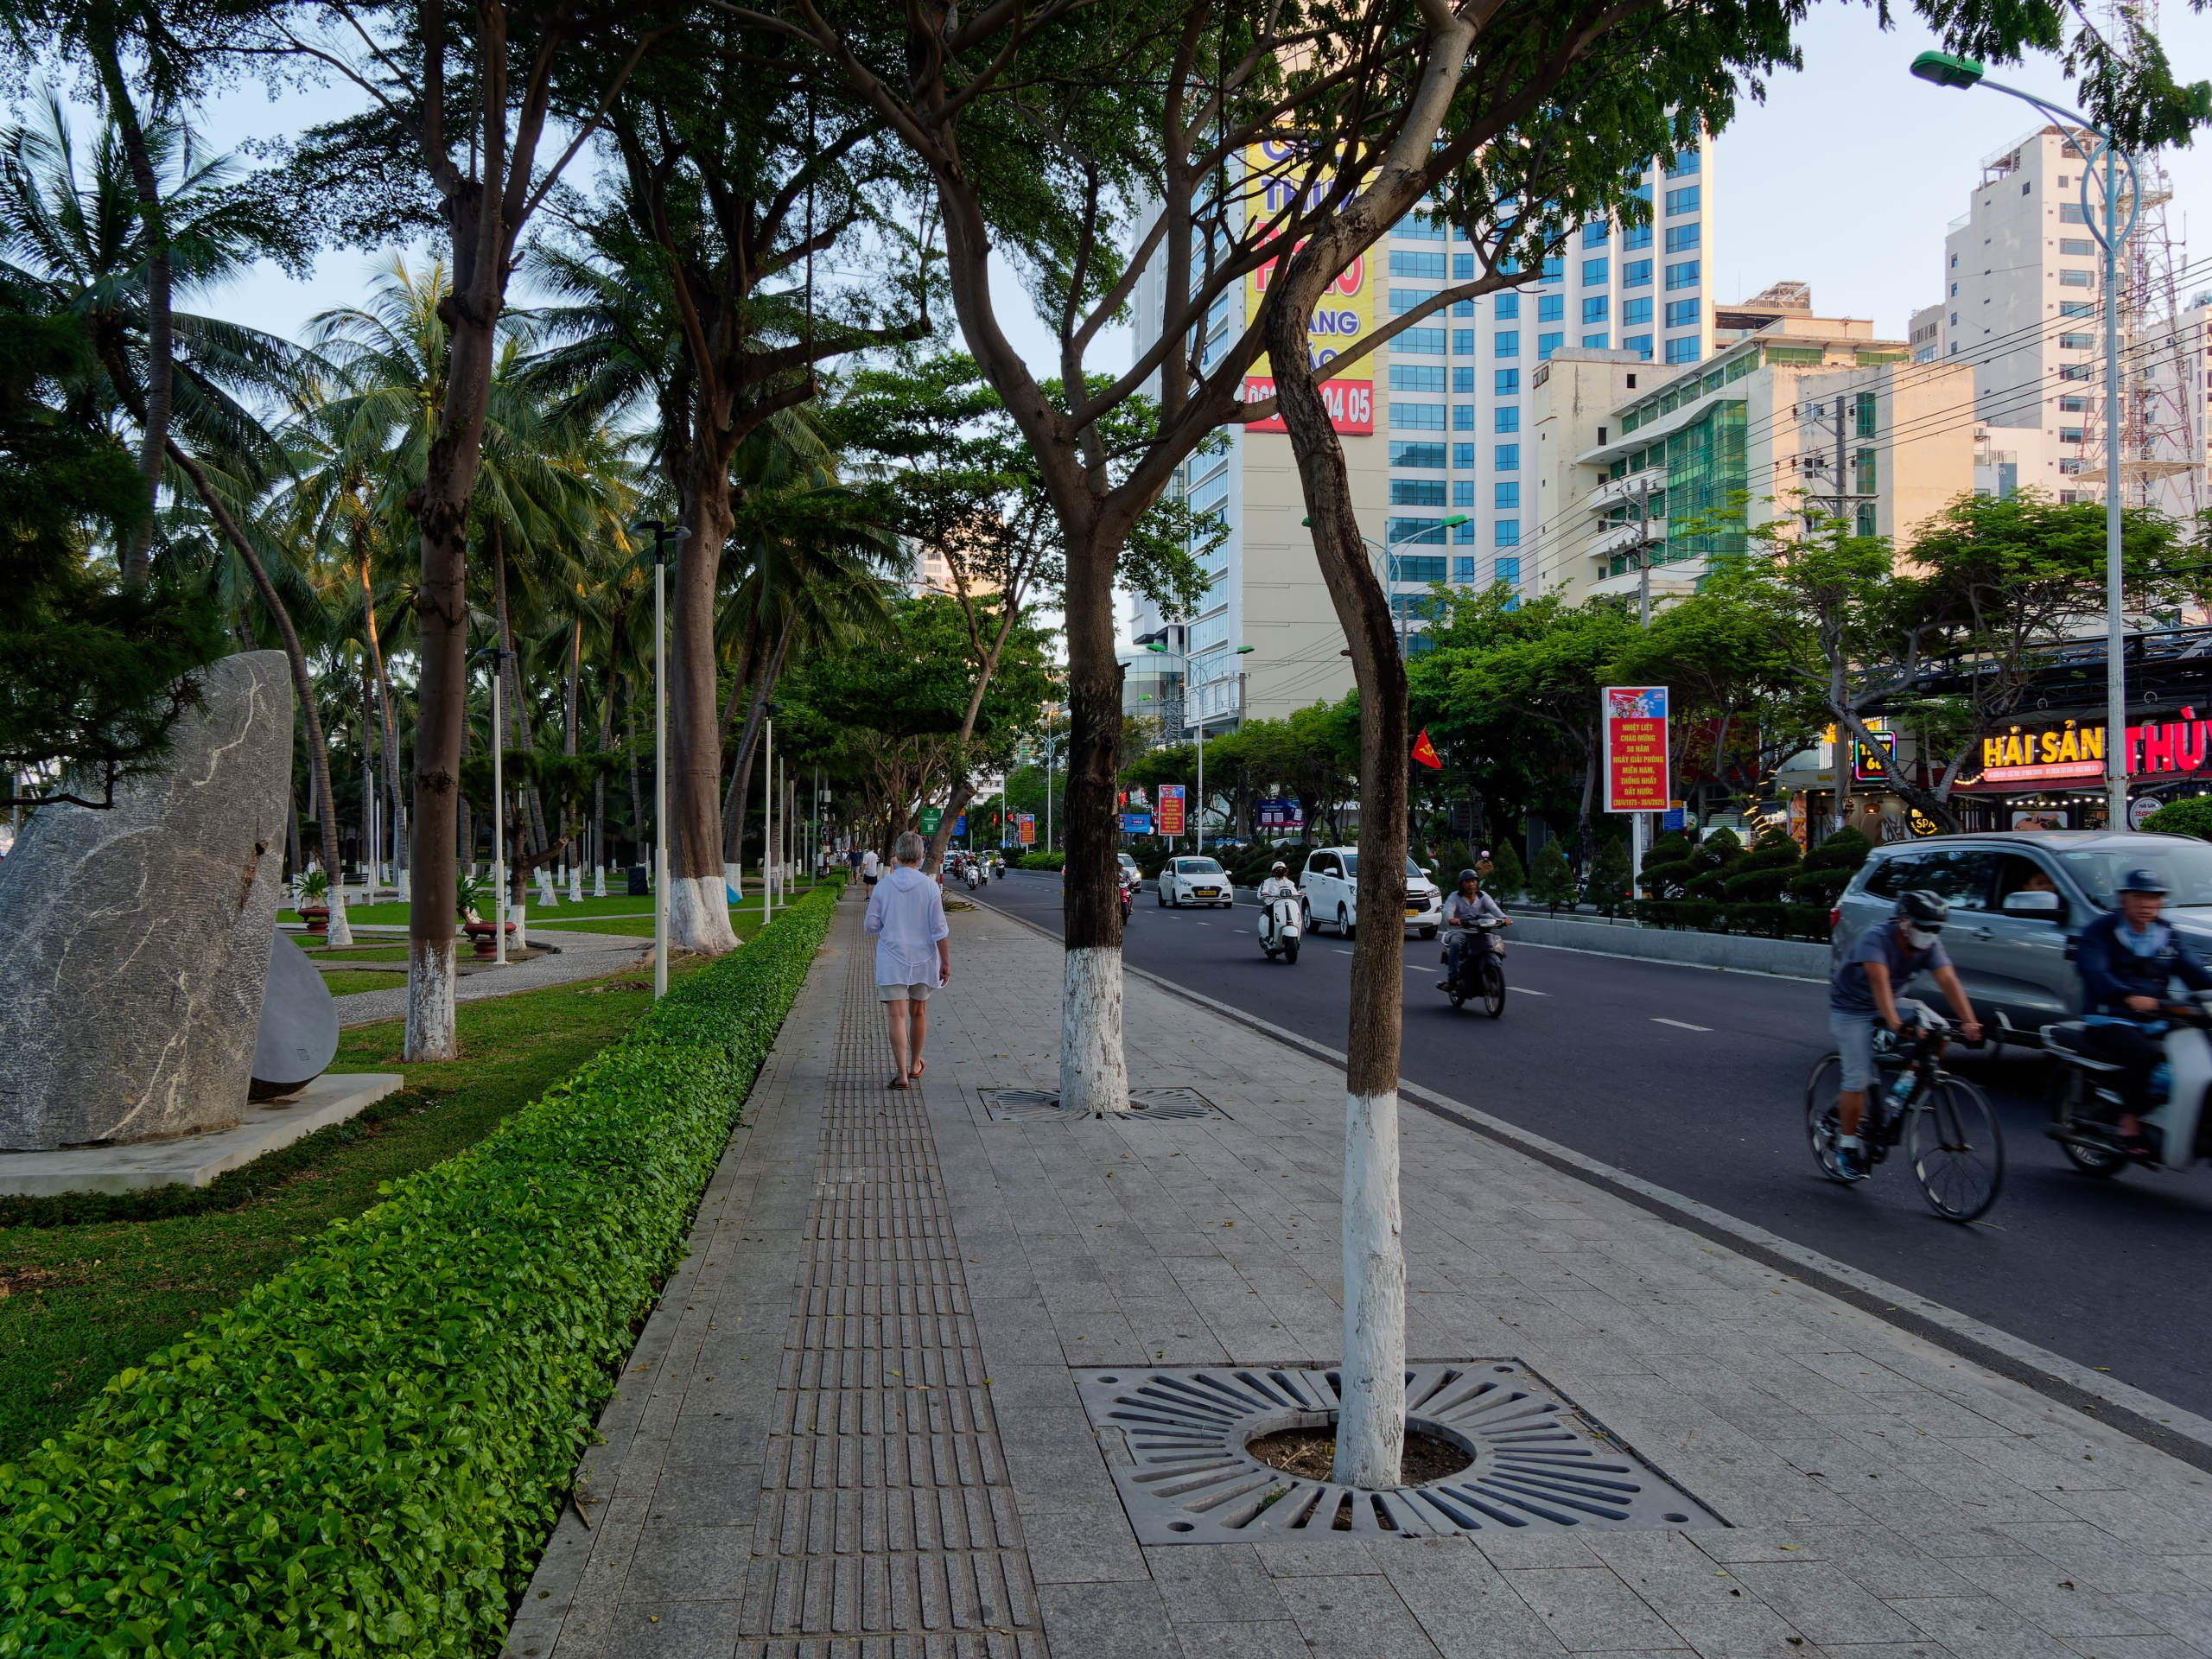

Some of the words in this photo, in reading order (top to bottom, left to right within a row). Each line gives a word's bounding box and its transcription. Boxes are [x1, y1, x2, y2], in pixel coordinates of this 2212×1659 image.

[1984, 725, 2031, 767] HẢI
[2041, 719, 2103, 763] SẢN
[2125, 705, 2212, 773] THÙ
[1916, 818, 1936, 829] SPA
